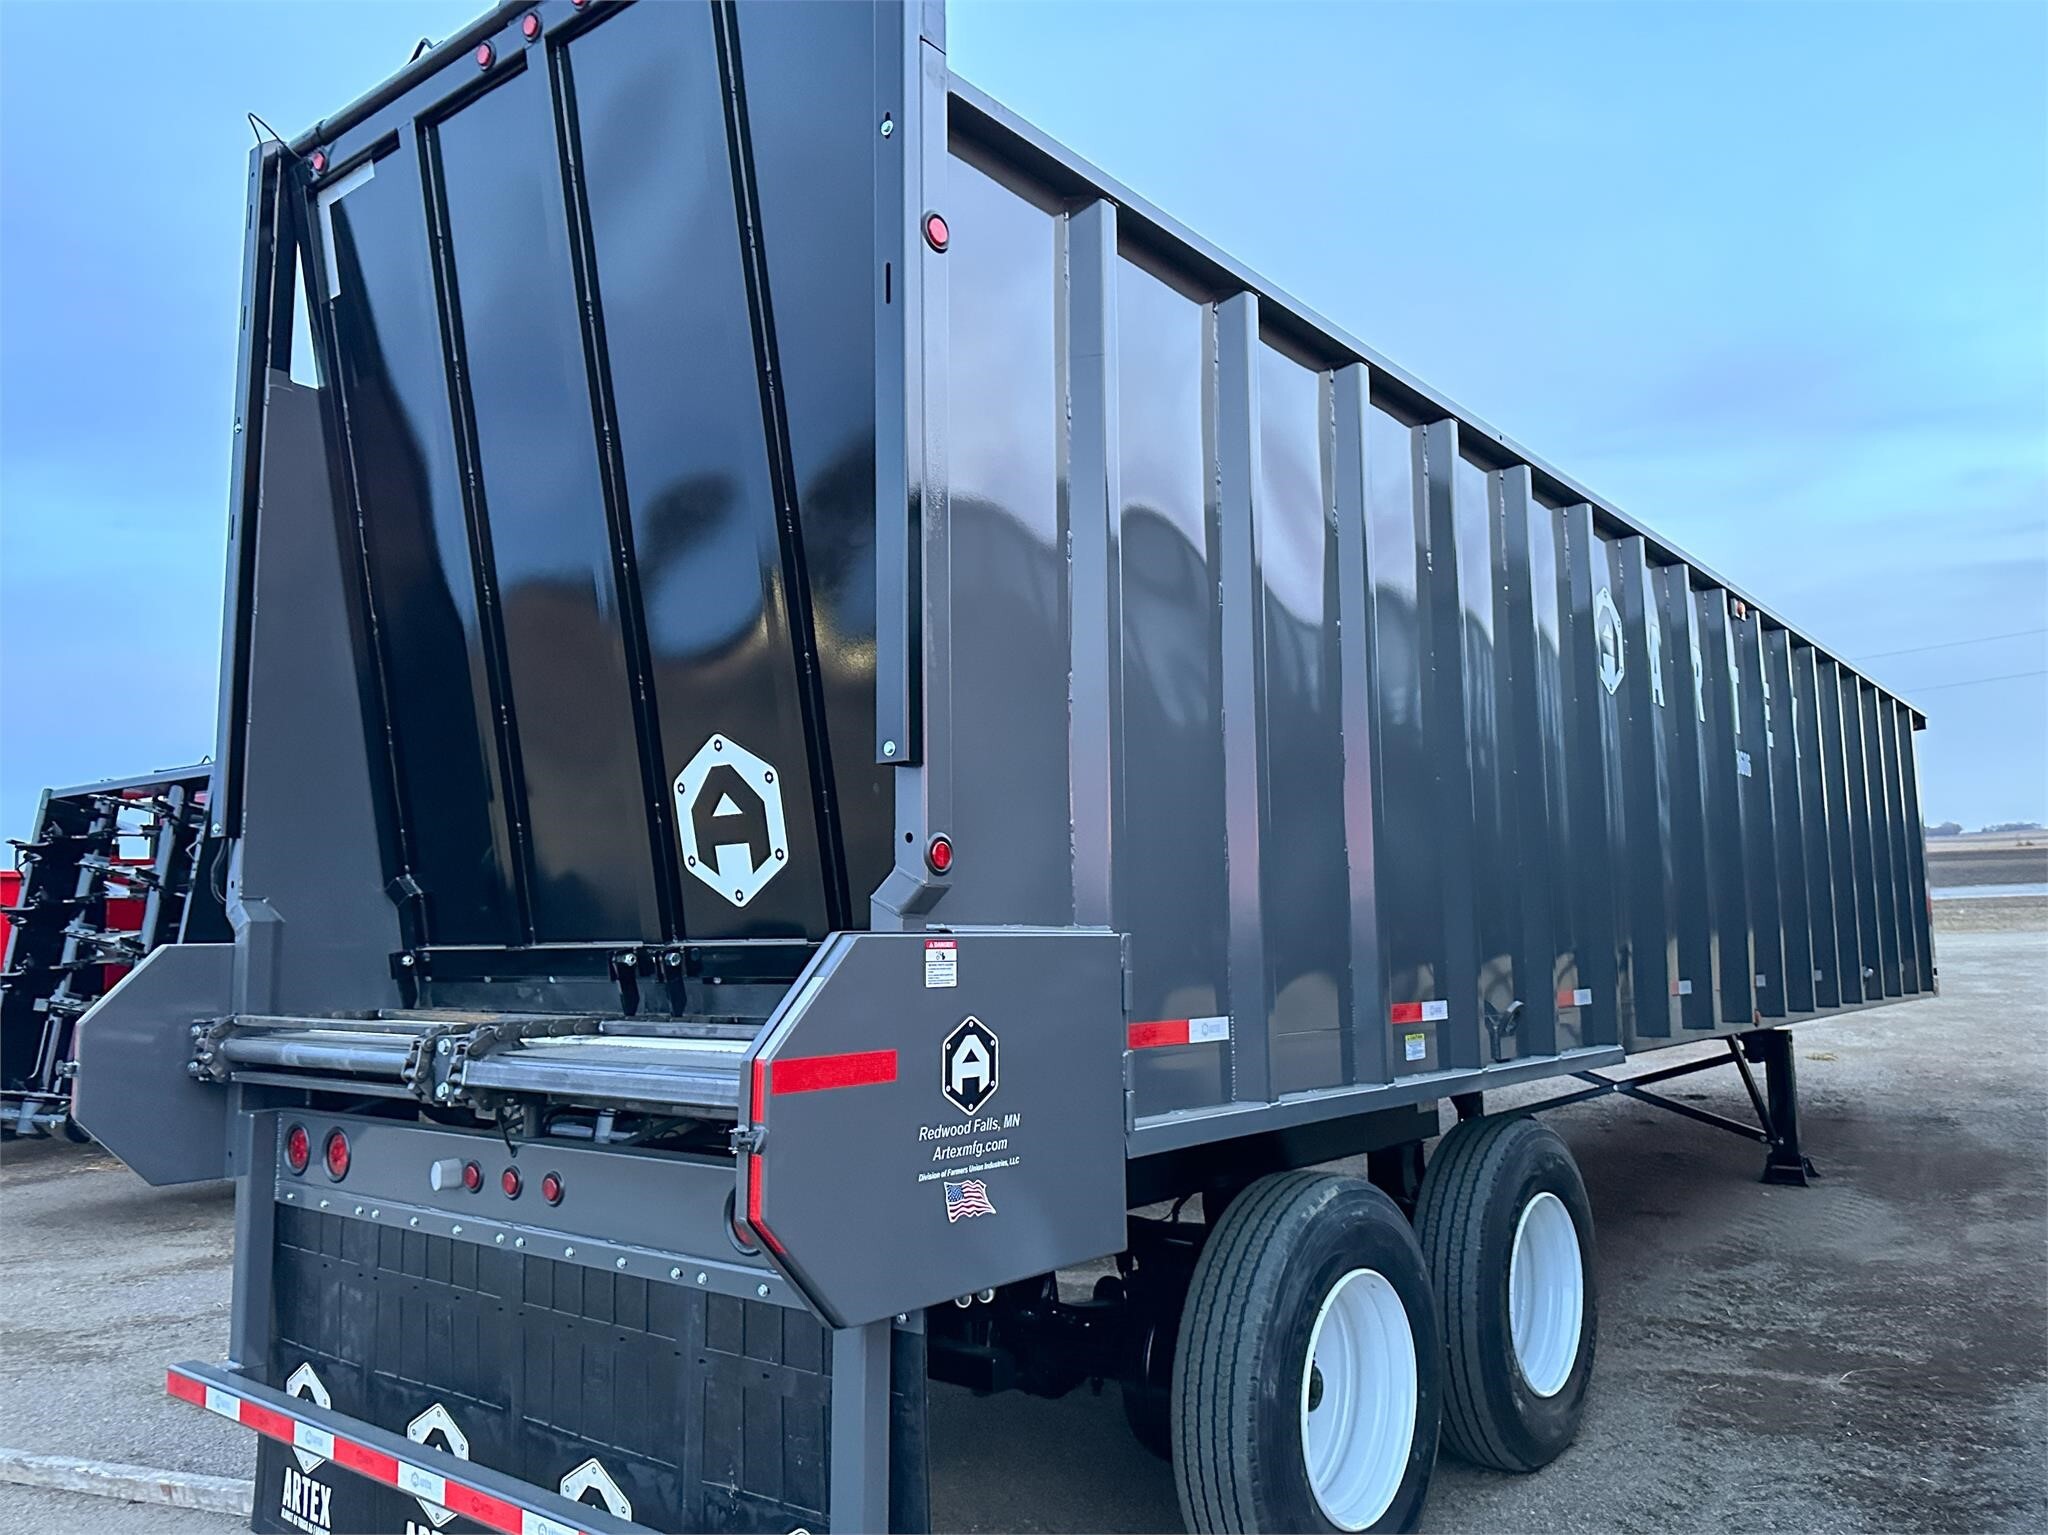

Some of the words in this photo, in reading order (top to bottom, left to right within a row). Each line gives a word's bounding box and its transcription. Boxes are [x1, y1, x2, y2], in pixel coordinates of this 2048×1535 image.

[919, 1120, 971, 1141] Redwood
[973, 1117, 1001, 1133] Falls,
[1003, 1113, 1021, 1128] MN
[932, 1138, 1008, 1161] Artexmfg.com
[918, 1171, 940, 1182] Division
[940, 1169, 947, 1177] of
[947, 1166, 969, 1177] Farmers
[968, 1164, 984, 1172] Union
[1009, 1156, 1021, 1165] LLC
[282, 1466, 332, 1529] ARTEX
